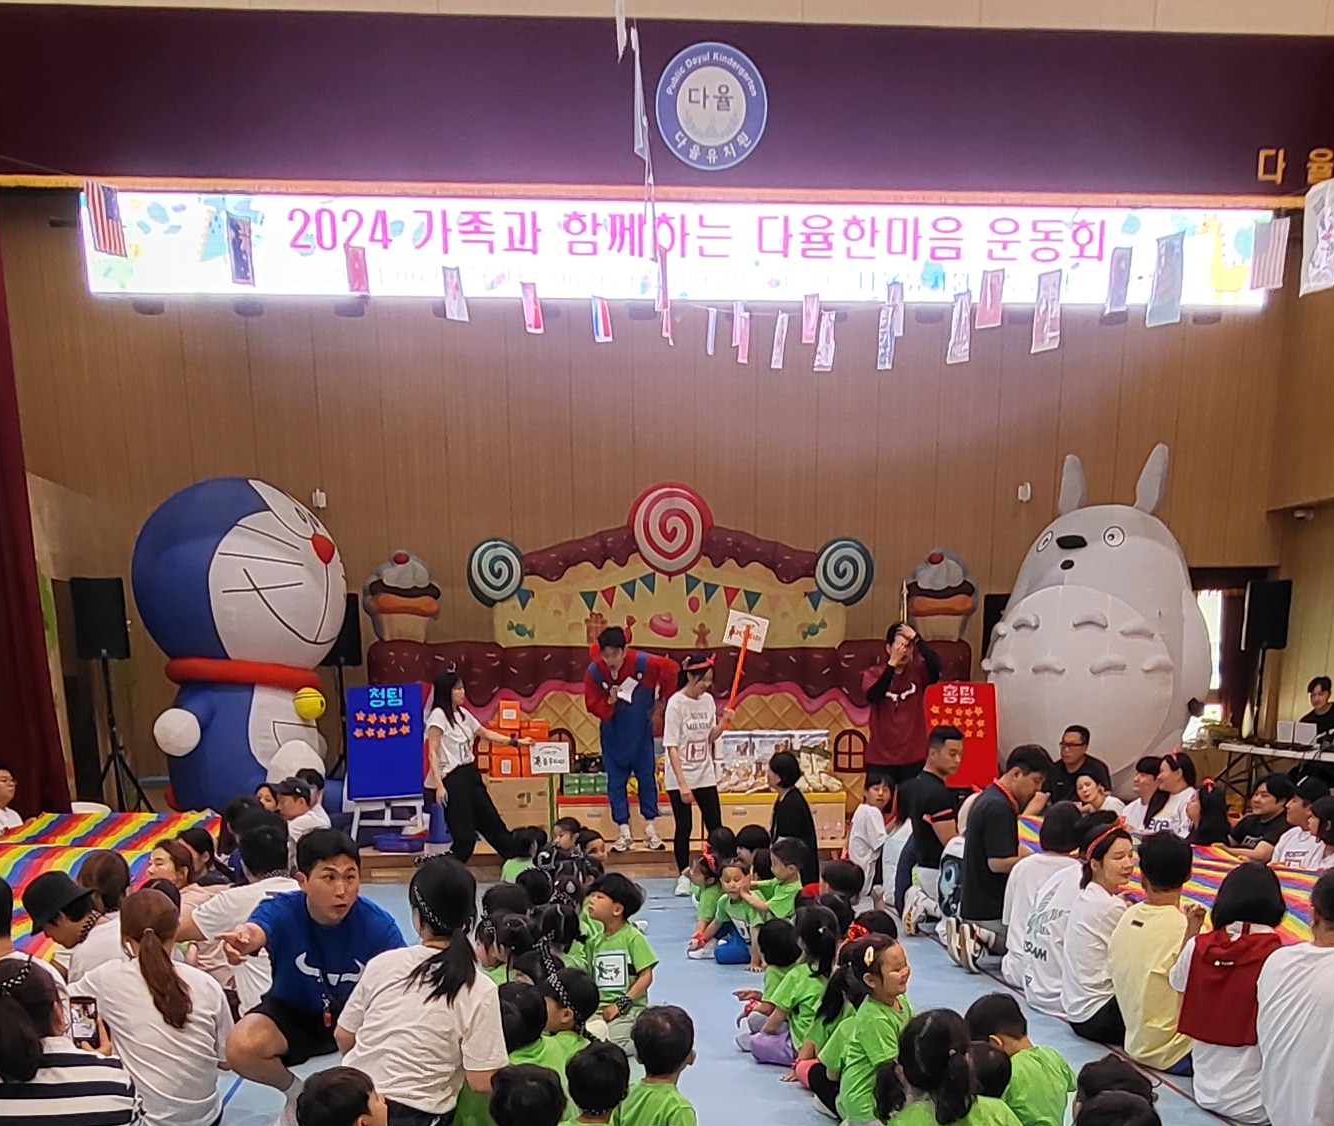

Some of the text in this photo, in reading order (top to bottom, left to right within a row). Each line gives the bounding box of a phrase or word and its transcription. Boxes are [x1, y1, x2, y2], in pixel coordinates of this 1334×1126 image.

[666, 52, 757, 97] Public Dayul Kindergarten
[688, 84, 734, 111] 다율
[674, 131, 752, 164] 다율유치원
[288, 208, 1106, 262] 2024 가족과 함께하는 다율한마음 운동회
[368, 687, 404, 708] 청팀
